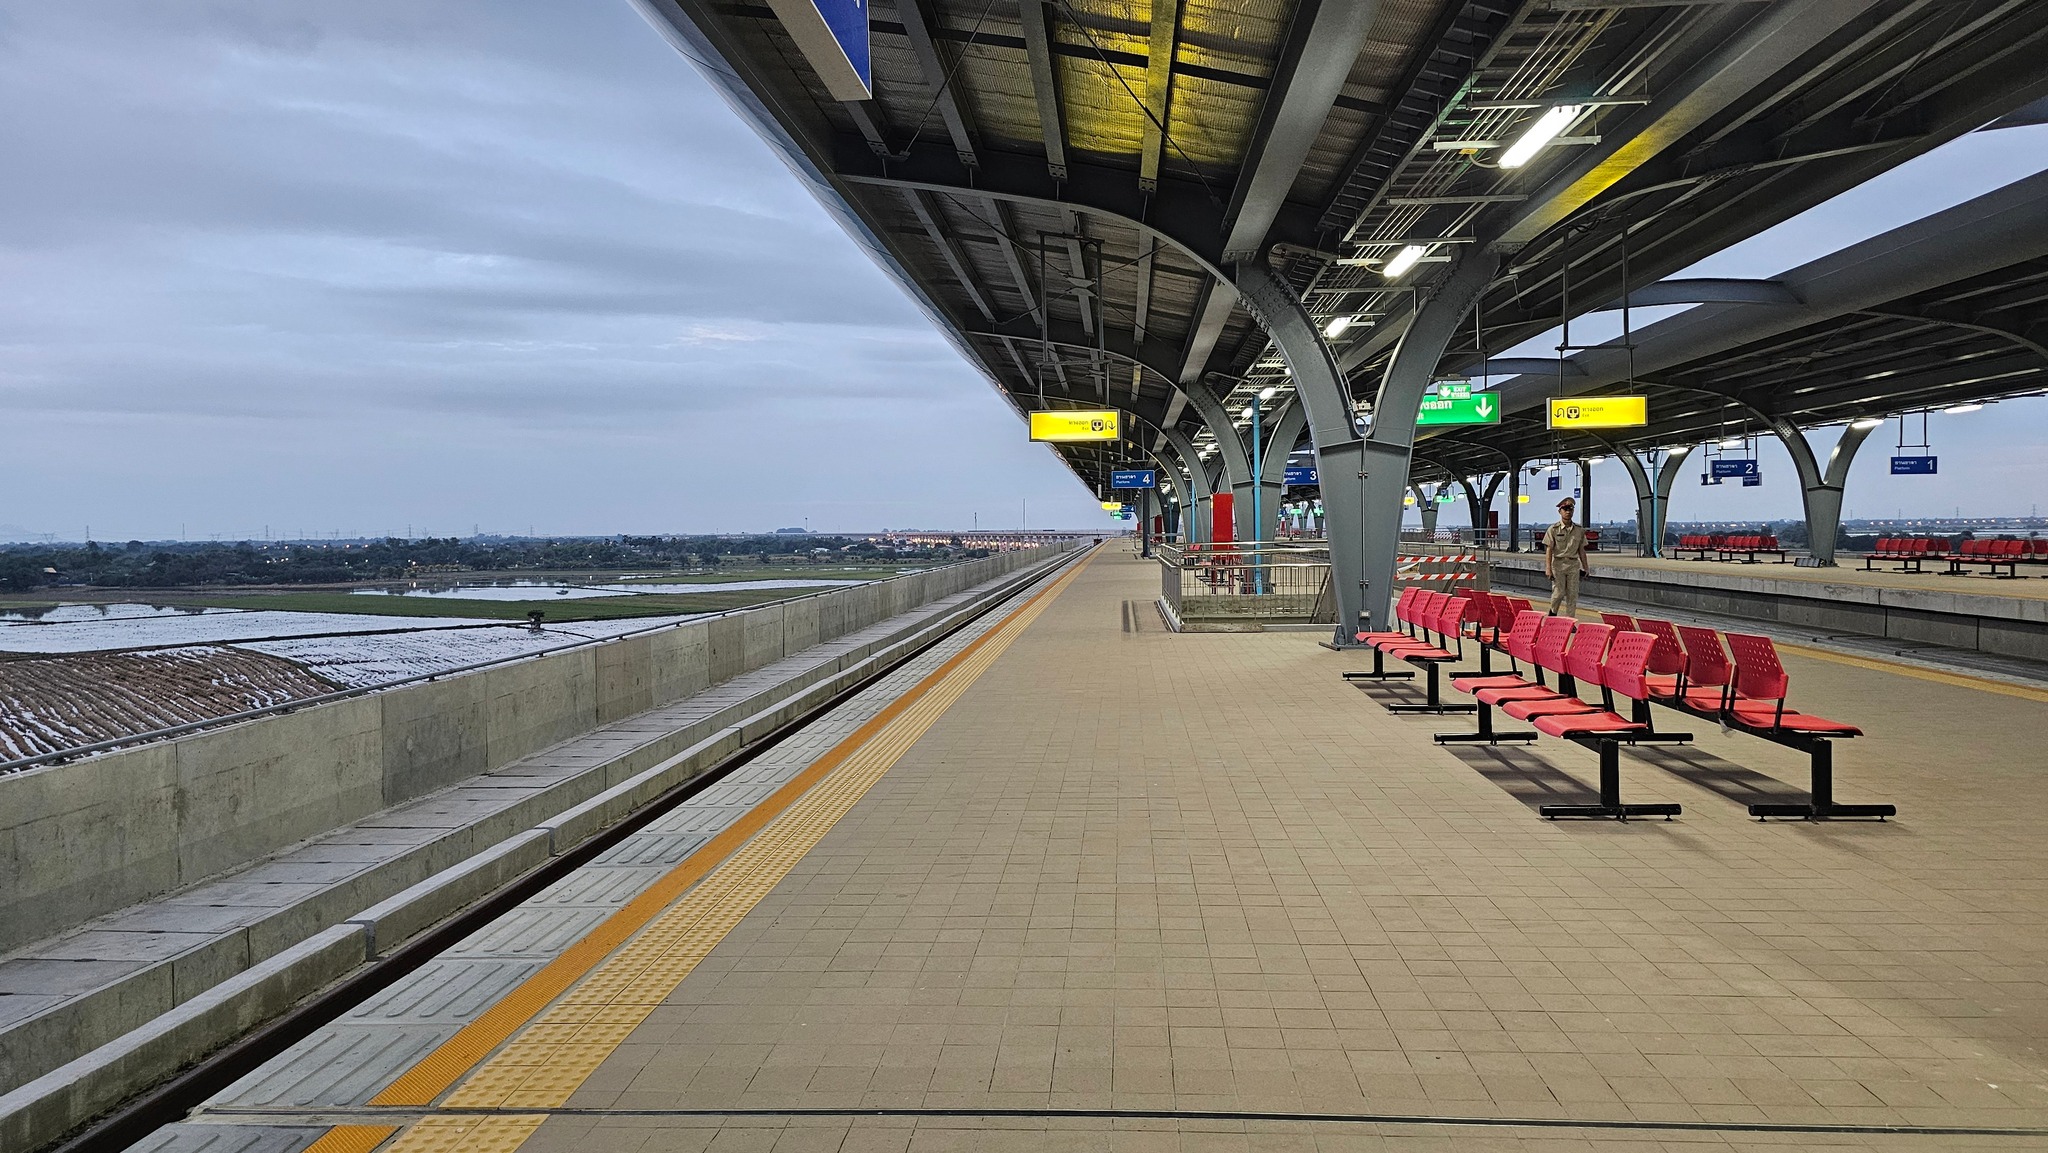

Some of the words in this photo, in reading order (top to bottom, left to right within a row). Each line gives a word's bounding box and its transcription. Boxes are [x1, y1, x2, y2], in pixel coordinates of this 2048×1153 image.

[1745, 464, 1753, 474] 2
[1928, 460, 1933, 470] 1
[1142, 473, 1150, 484] 4
[1310, 471, 1316, 480] 3
